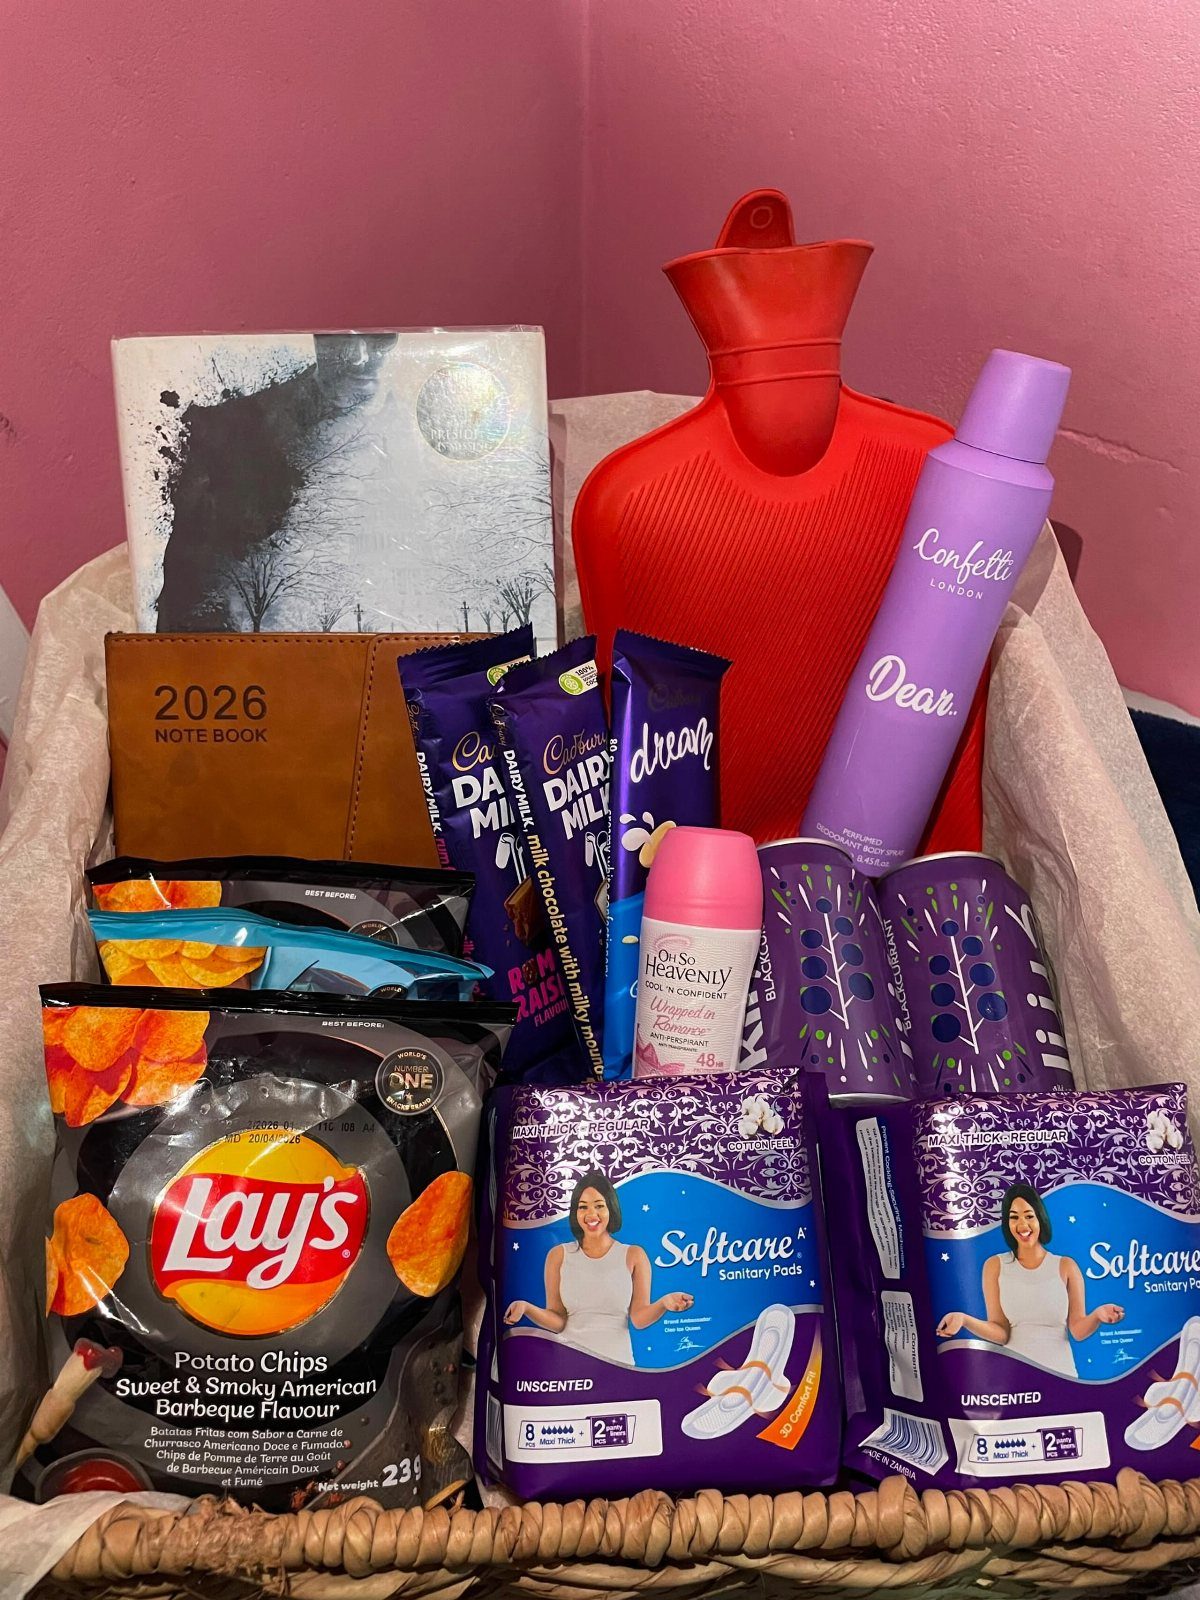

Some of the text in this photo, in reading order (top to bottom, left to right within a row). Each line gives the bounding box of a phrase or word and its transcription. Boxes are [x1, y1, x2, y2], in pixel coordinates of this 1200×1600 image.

[913, 528, 1014, 585] Confetti
[929, 578, 984, 600] LONDON
[154, 685, 267, 720] 2026
[155, 728, 268, 742] NOTE BOOK
[630, 717, 714, 783] dream
[416, 752, 434, 797] DAIRY
[503, 749, 526, 798] DAIRY
[452, 766, 504, 809] DA
[517, 796, 535, 833] MILK,
[816, 822, 862, 850] DEODORANT
[862, 845, 885, 856] BODY
[842, 828, 883, 846] PERFUMED
[527, 834, 550, 868] milk
[305, 889, 325, 898] BEST
[537, 868, 568, 944] chocolate
[558, 944, 581, 980] with
[759, 926, 777, 1002] BLACKCU
[883, 919, 912, 1030] BLACKCURRANT
[645, 980, 663, 992] COOL
[677, 988, 727, 1000] CONFIDENT
[568, 981, 591, 1023] milky
[650, 996, 716, 1020] Wrapped in
[650, 1032, 709, 1047] ANTI-PERSPIRANT
[397, 1051, 427, 1061] WORLD'S
[394, 1064, 429, 1073] NUMBER
[388, 1071, 434, 1090] ONE
[410, 1097, 432, 1110] BRAND
[512, 1119, 650, 1139] MAXI THICK REGULAR
[928, 1130, 1067, 1147] MAXI THICK REGULAR
[728, 1139, 794, 1151] COTTON FEEL
[880, 1125, 890, 1155] Prevent
[1139, 1154, 1175, 1165] COTTON
[162, 1175, 359, 1290] Lay's
[654, 1226, 794, 1277] Softcare
[719, 1263, 802, 1281] Sanitary Pads
[1086, 1239, 1200, 1290] Softcare
[1144, 1278, 1200, 1293] Sanitary Pa
[174, 1350, 328, 1378] Potato Chips
[116, 1376, 377, 1401] Sweet & Smoky American
[516, 1378, 593, 1393] UNSCENTED
[780, 1370, 817, 1438] 3D Comfort Fit
[961, 1391, 1042, 1406] UNSCENTED
[156, 1399, 340, 1423] Barbeque Flavour
[151, 1426, 193, 1437] Batatas
[195, 1427, 225, 1438] Fritas
[227, 1430, 250, 1439] com
[251, 1428, 285, 1439] Sabor
[296, 1429, 328, 1438] Carne
[330, 1427, 343, 1437] de
[525, 1420, 606, 1441] 8 2
[606, 1424, 623, 1432] panty
[609, 1429, 626, 1437] liners
[144, 1438, 201, 1448] Churrasco
[203, 1439, 260, 1451] Americano
[263, 1441, 290, 1451] Doce
[540, 1437, 556, 1445] Maxi
[558, 1437, 576, 1445] Thick
[977, 1433, 1057, 1455] 8 2
[156, 1450, 331, 1463] Chips de Pomme de Terre au Goût
[993, 1451, 1009, 1459] Maxi
[1011, 1450, 1029, 1458] Thick
[167, 1462, 320, 1475] de Barbecue Américain Doux
[881, 1455, 890, 1467] IN
[889, 1460, 917, 1481] ZAMBIA
[221, 1476, 263, 1487] et Fumé
[318, 1482, 339, 1492] Net
[341, 1479, 379, 1491] weight
